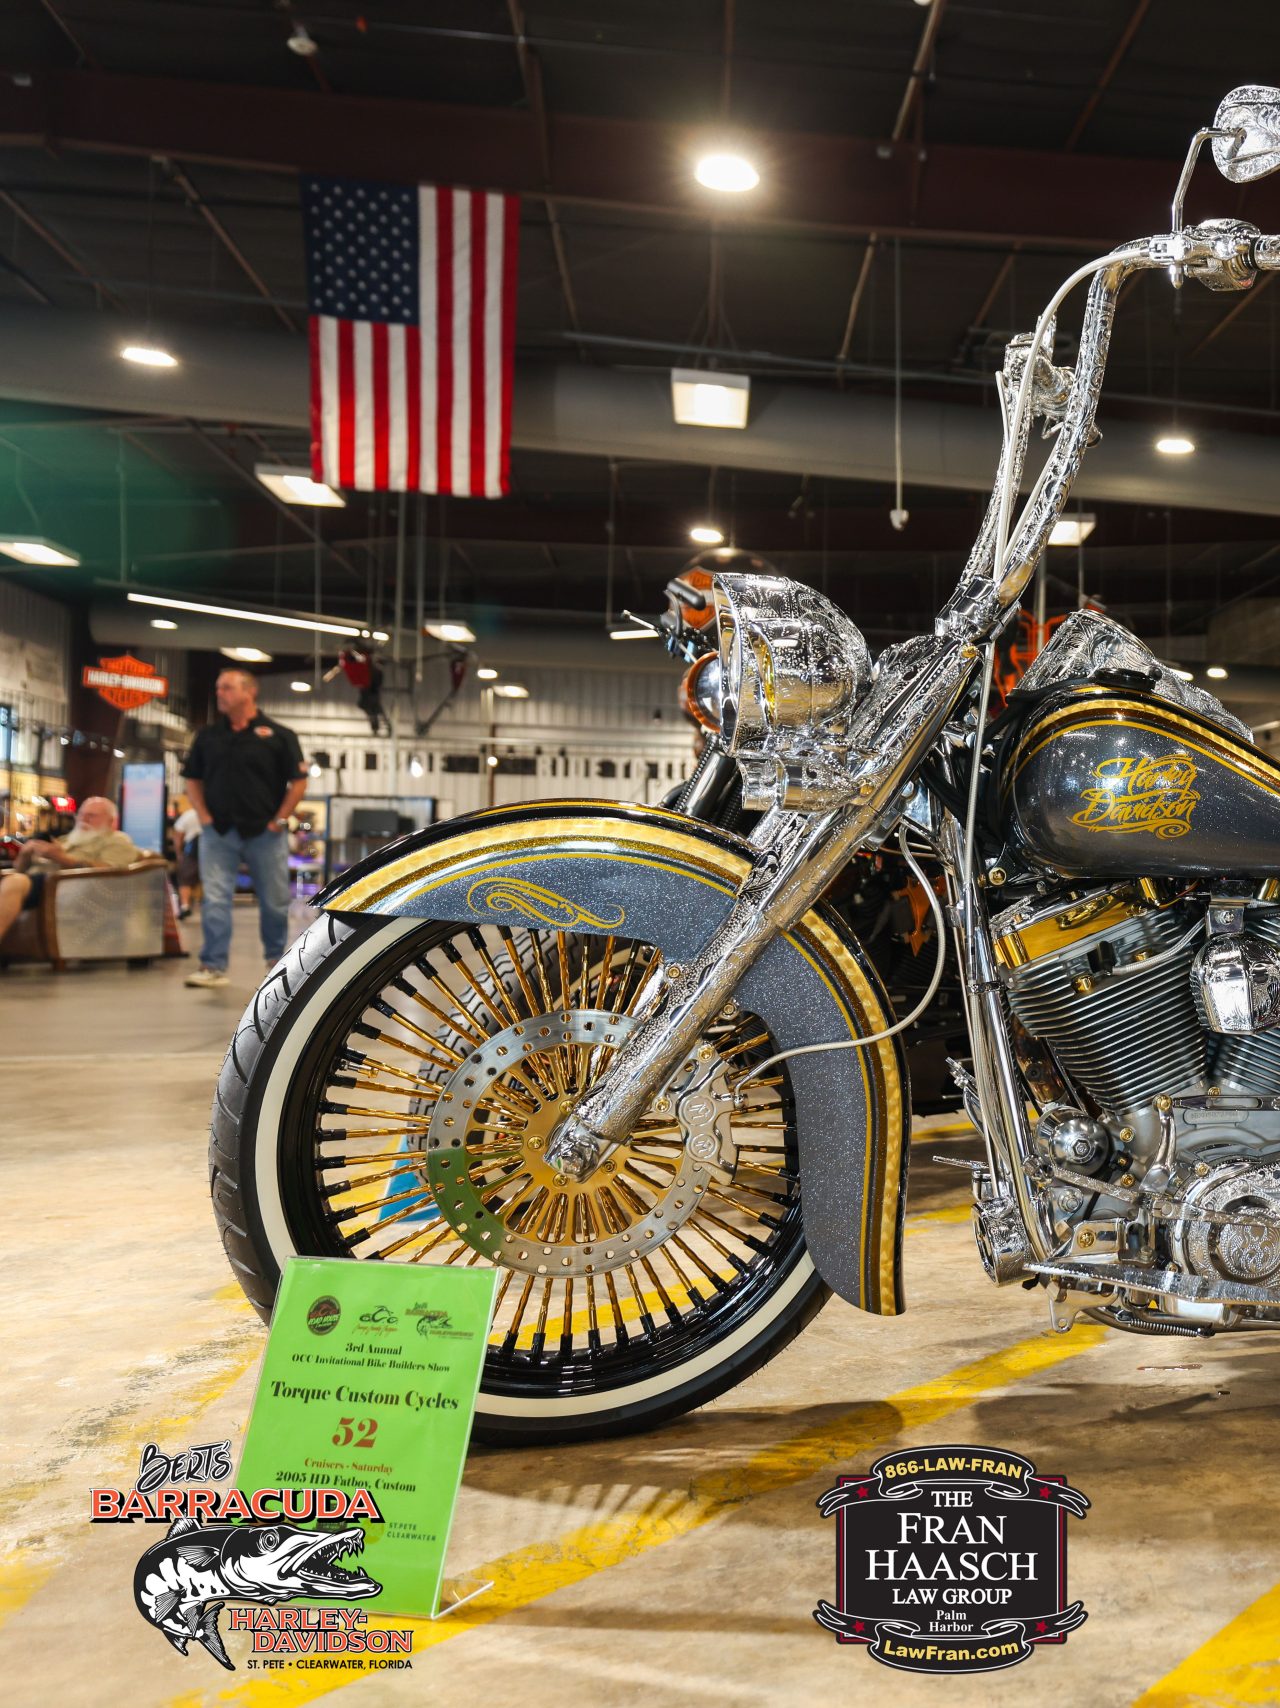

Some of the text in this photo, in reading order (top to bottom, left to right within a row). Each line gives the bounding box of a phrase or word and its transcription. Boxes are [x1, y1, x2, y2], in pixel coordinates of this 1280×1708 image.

[1091, 753, 1198, 797] Harley
[1070, 788, 1200, 832] Davidson
[345, 1342, 403, 1355] 3rd Annual
[292, 1353, 451, 1373] OCC Invitational Bike Builders Show
[271, 1381, 459, 1412] Torque Custom Cycles
[331, 1416, 379, 1449] 52
[304, 1457, 345, 1470] Cruisers
[351, 1461, 394, 1475] Saturday
[275, 1470, 307, 1483] 2005
[310, 1474, 331, 1485] HD
[375, 1478, 416, 1492] Custom
[386, 1531, 437, 1542] CLEARWATER
